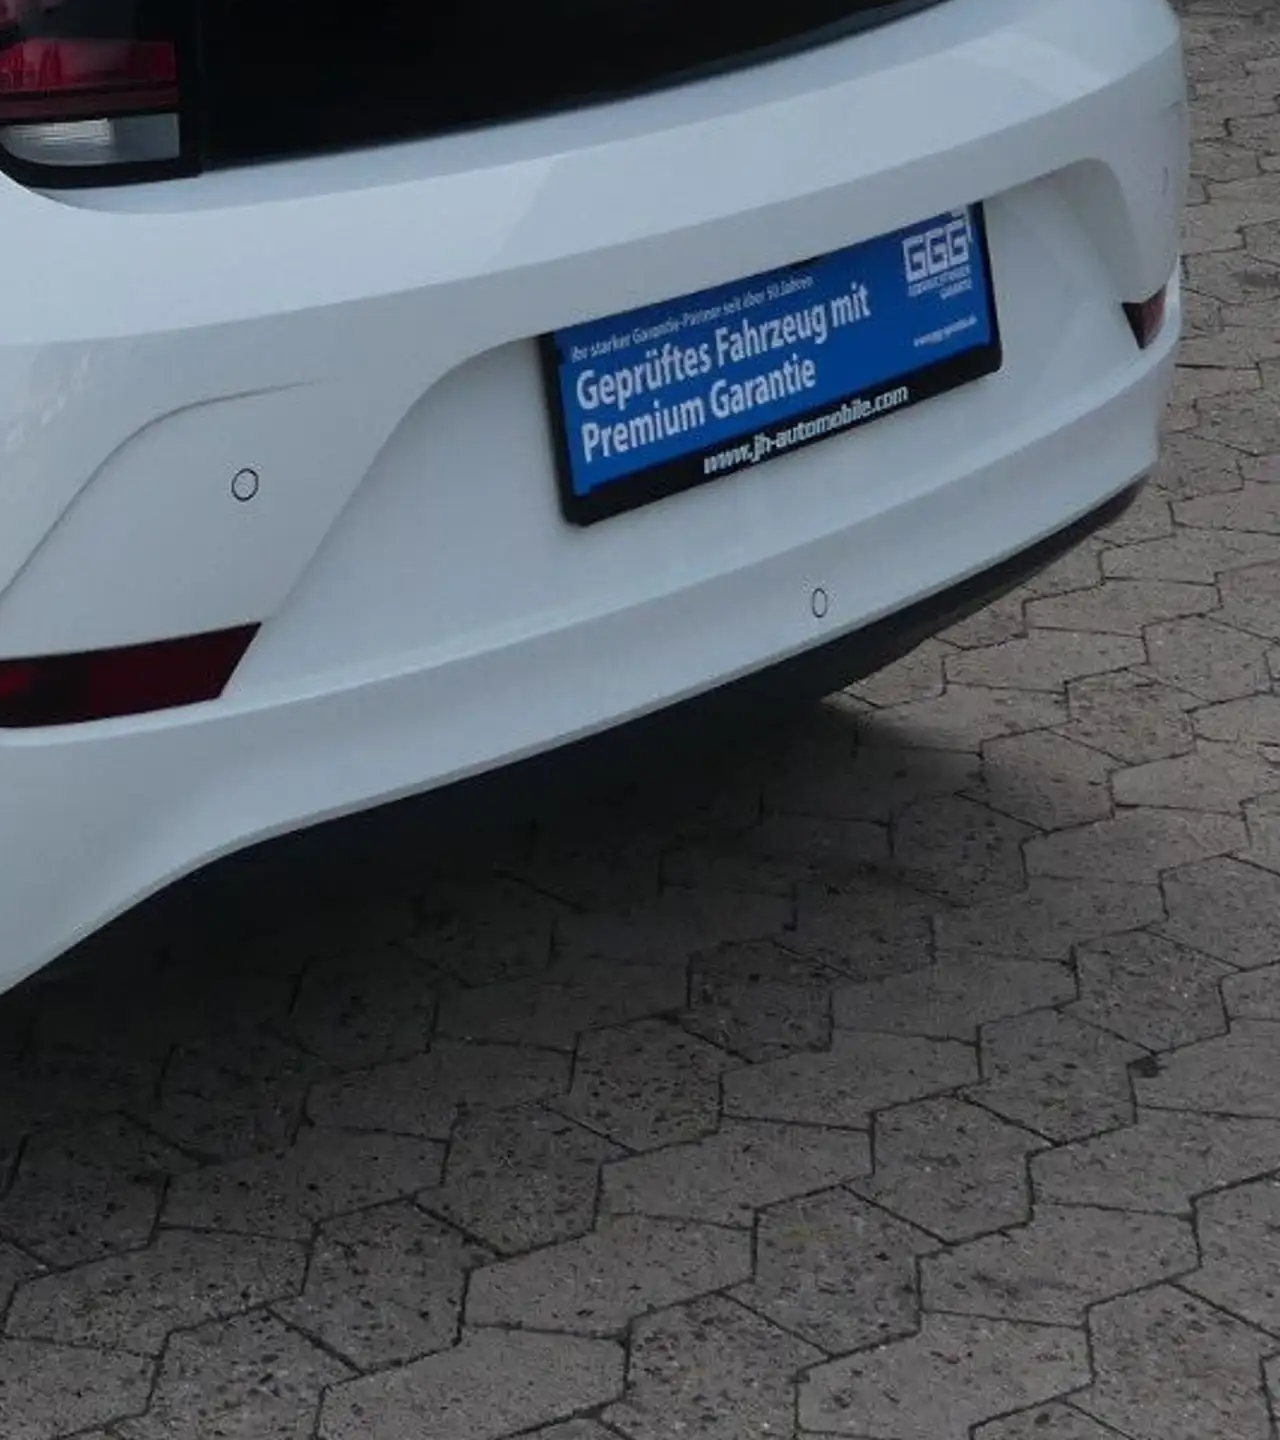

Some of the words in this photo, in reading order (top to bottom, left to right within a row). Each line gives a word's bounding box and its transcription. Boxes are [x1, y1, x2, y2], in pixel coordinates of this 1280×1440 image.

[576, 342, 712, 411] Geprüftes
[715, 304, 828, 368] Fahrzeug
[831, 280, 872, 329] mit
[581, 396, 706, 464] Premium
[709, 353, 817, 419] Garantie
[703, 385, 909, 475] www.jh-automobile.com
